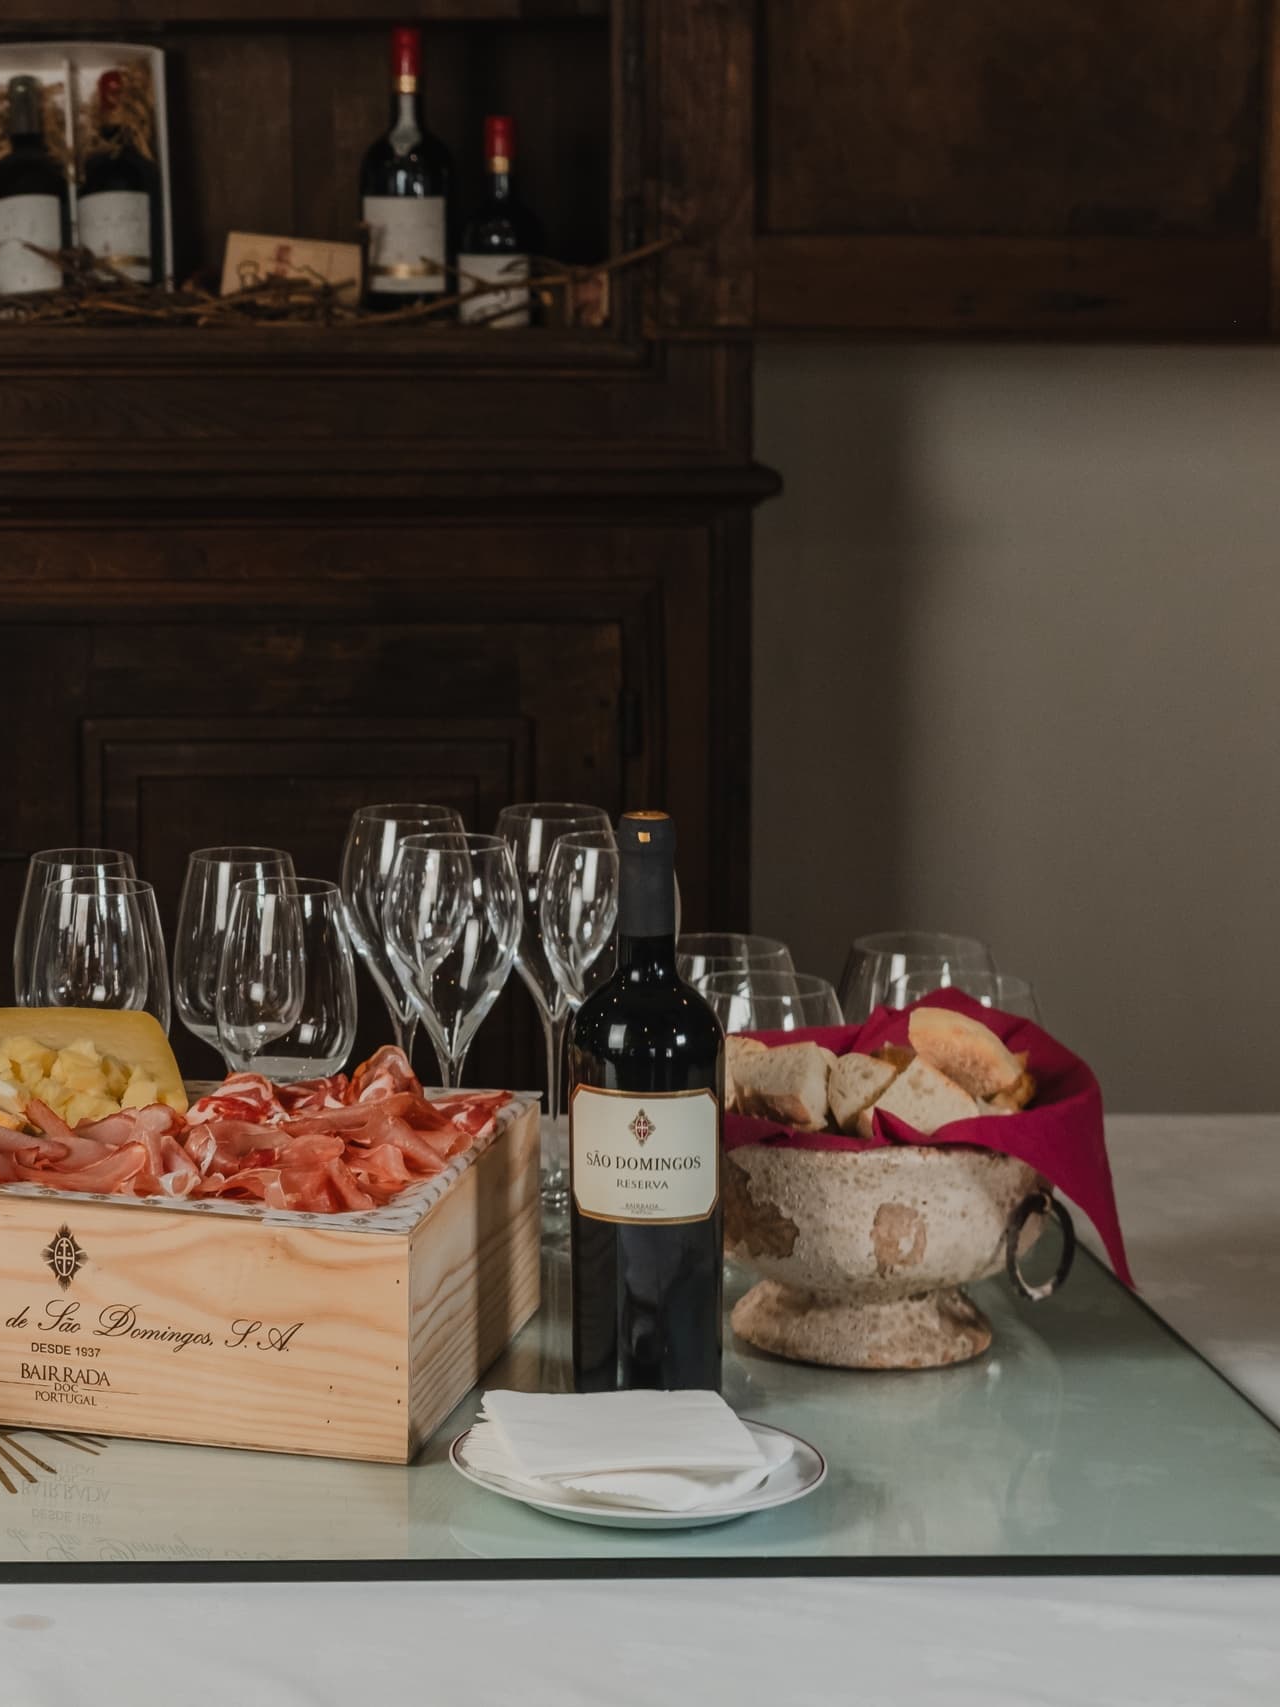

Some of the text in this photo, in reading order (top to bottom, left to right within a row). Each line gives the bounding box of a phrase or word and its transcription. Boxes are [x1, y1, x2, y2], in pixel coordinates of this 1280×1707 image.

[586, 1150, 701, 1171] SÃO DOMINGOS
[616, 1179, 669, 1190] RESERVA
[5, 1306, 30, 1329] de
[37, 1299, 81, 1333] São
[31, 1342, 101, 1358] DESDE 1937
[20, 1362, 111, 1387] BAIRRADA
[54, 1382, 79, 1393] DOC
[35, 1390, 97, 1406] PORTUGAL
